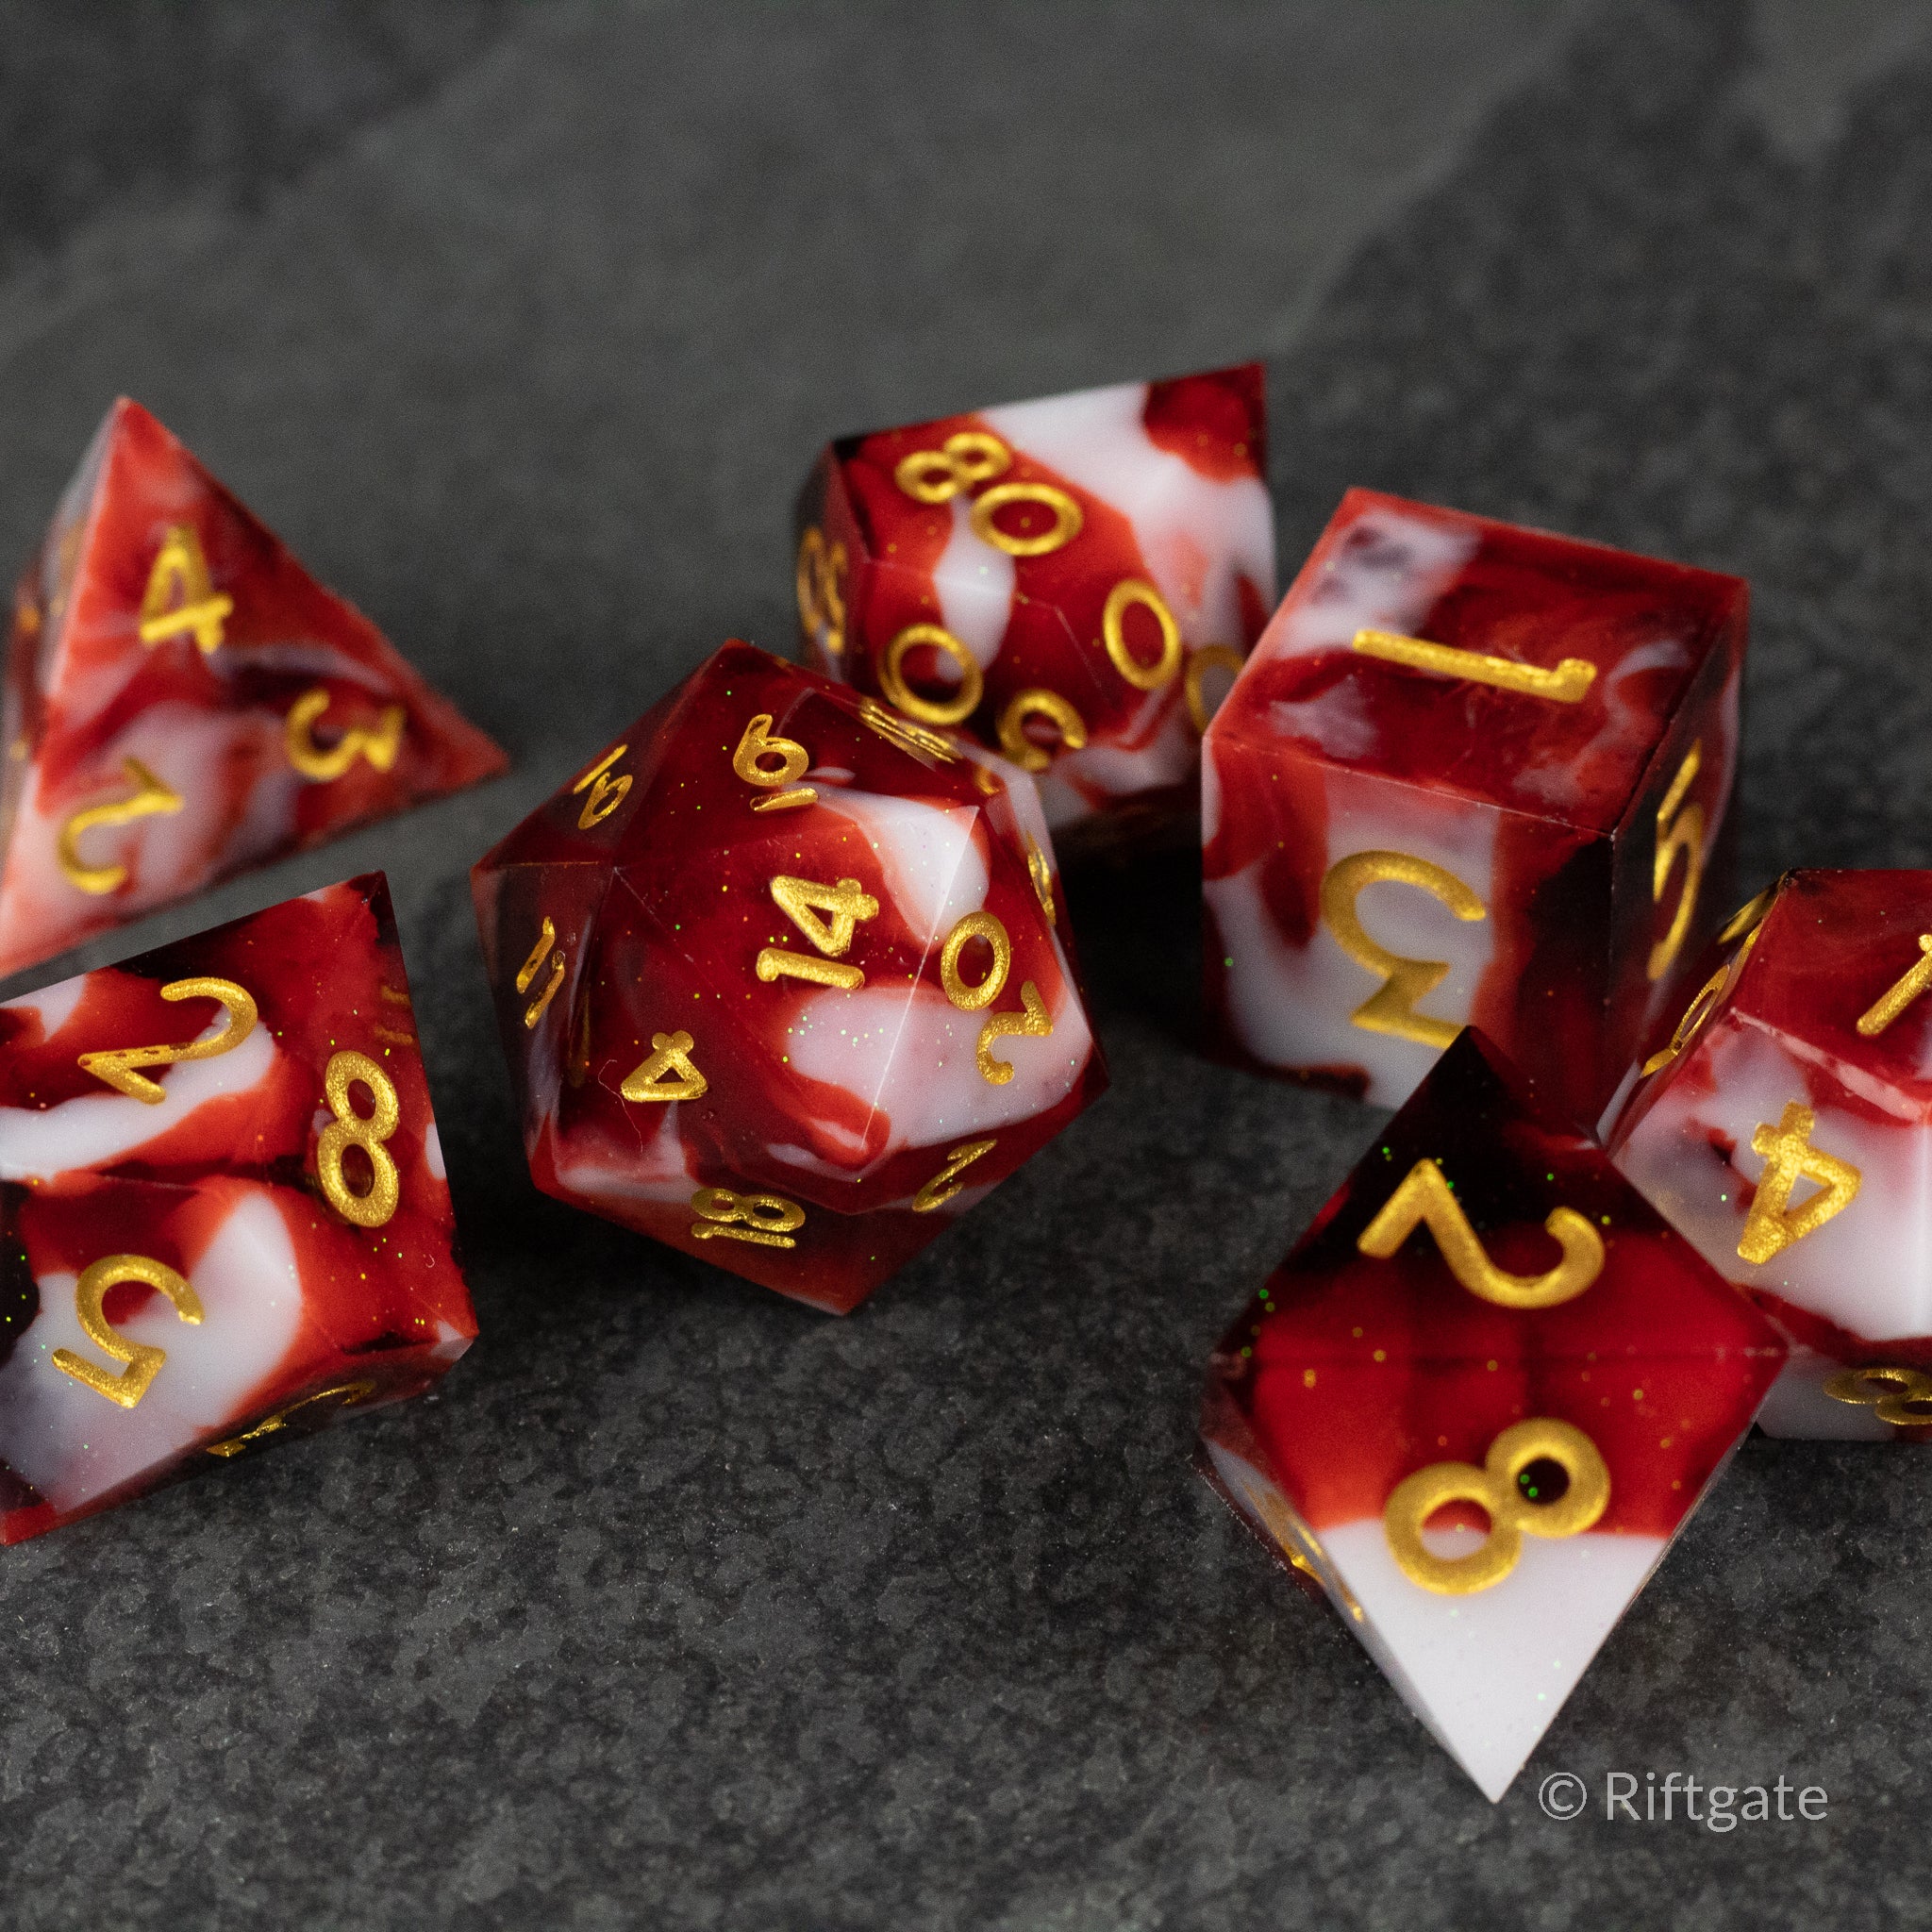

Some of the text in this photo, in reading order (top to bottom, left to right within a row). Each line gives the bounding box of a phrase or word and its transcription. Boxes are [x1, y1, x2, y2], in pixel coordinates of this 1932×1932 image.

[141, 524, 234, 653] 4
[1353, 629, 1597, 704] 1
[285, 690, 406, 782] 3
[58, 758, 184, 894] 2
[755, 875, 879, 990] 14
[941, 911, 1053, 1085] 20
[1320, 850, 1487, 1051] 3
[78, 976, 258, 1105] 2
[621, 1029, 708, 1104] 4
[317, 1051, 399, 1228] 8
[1738, 1101, 1861, 1265] 4
[691, 1187, 806, 1248] 18
[1357, 1158, 1606, 1309] 2
[52, 1255, 206, 1408] 5
[1383, 1417, 1611, 1596] 8
